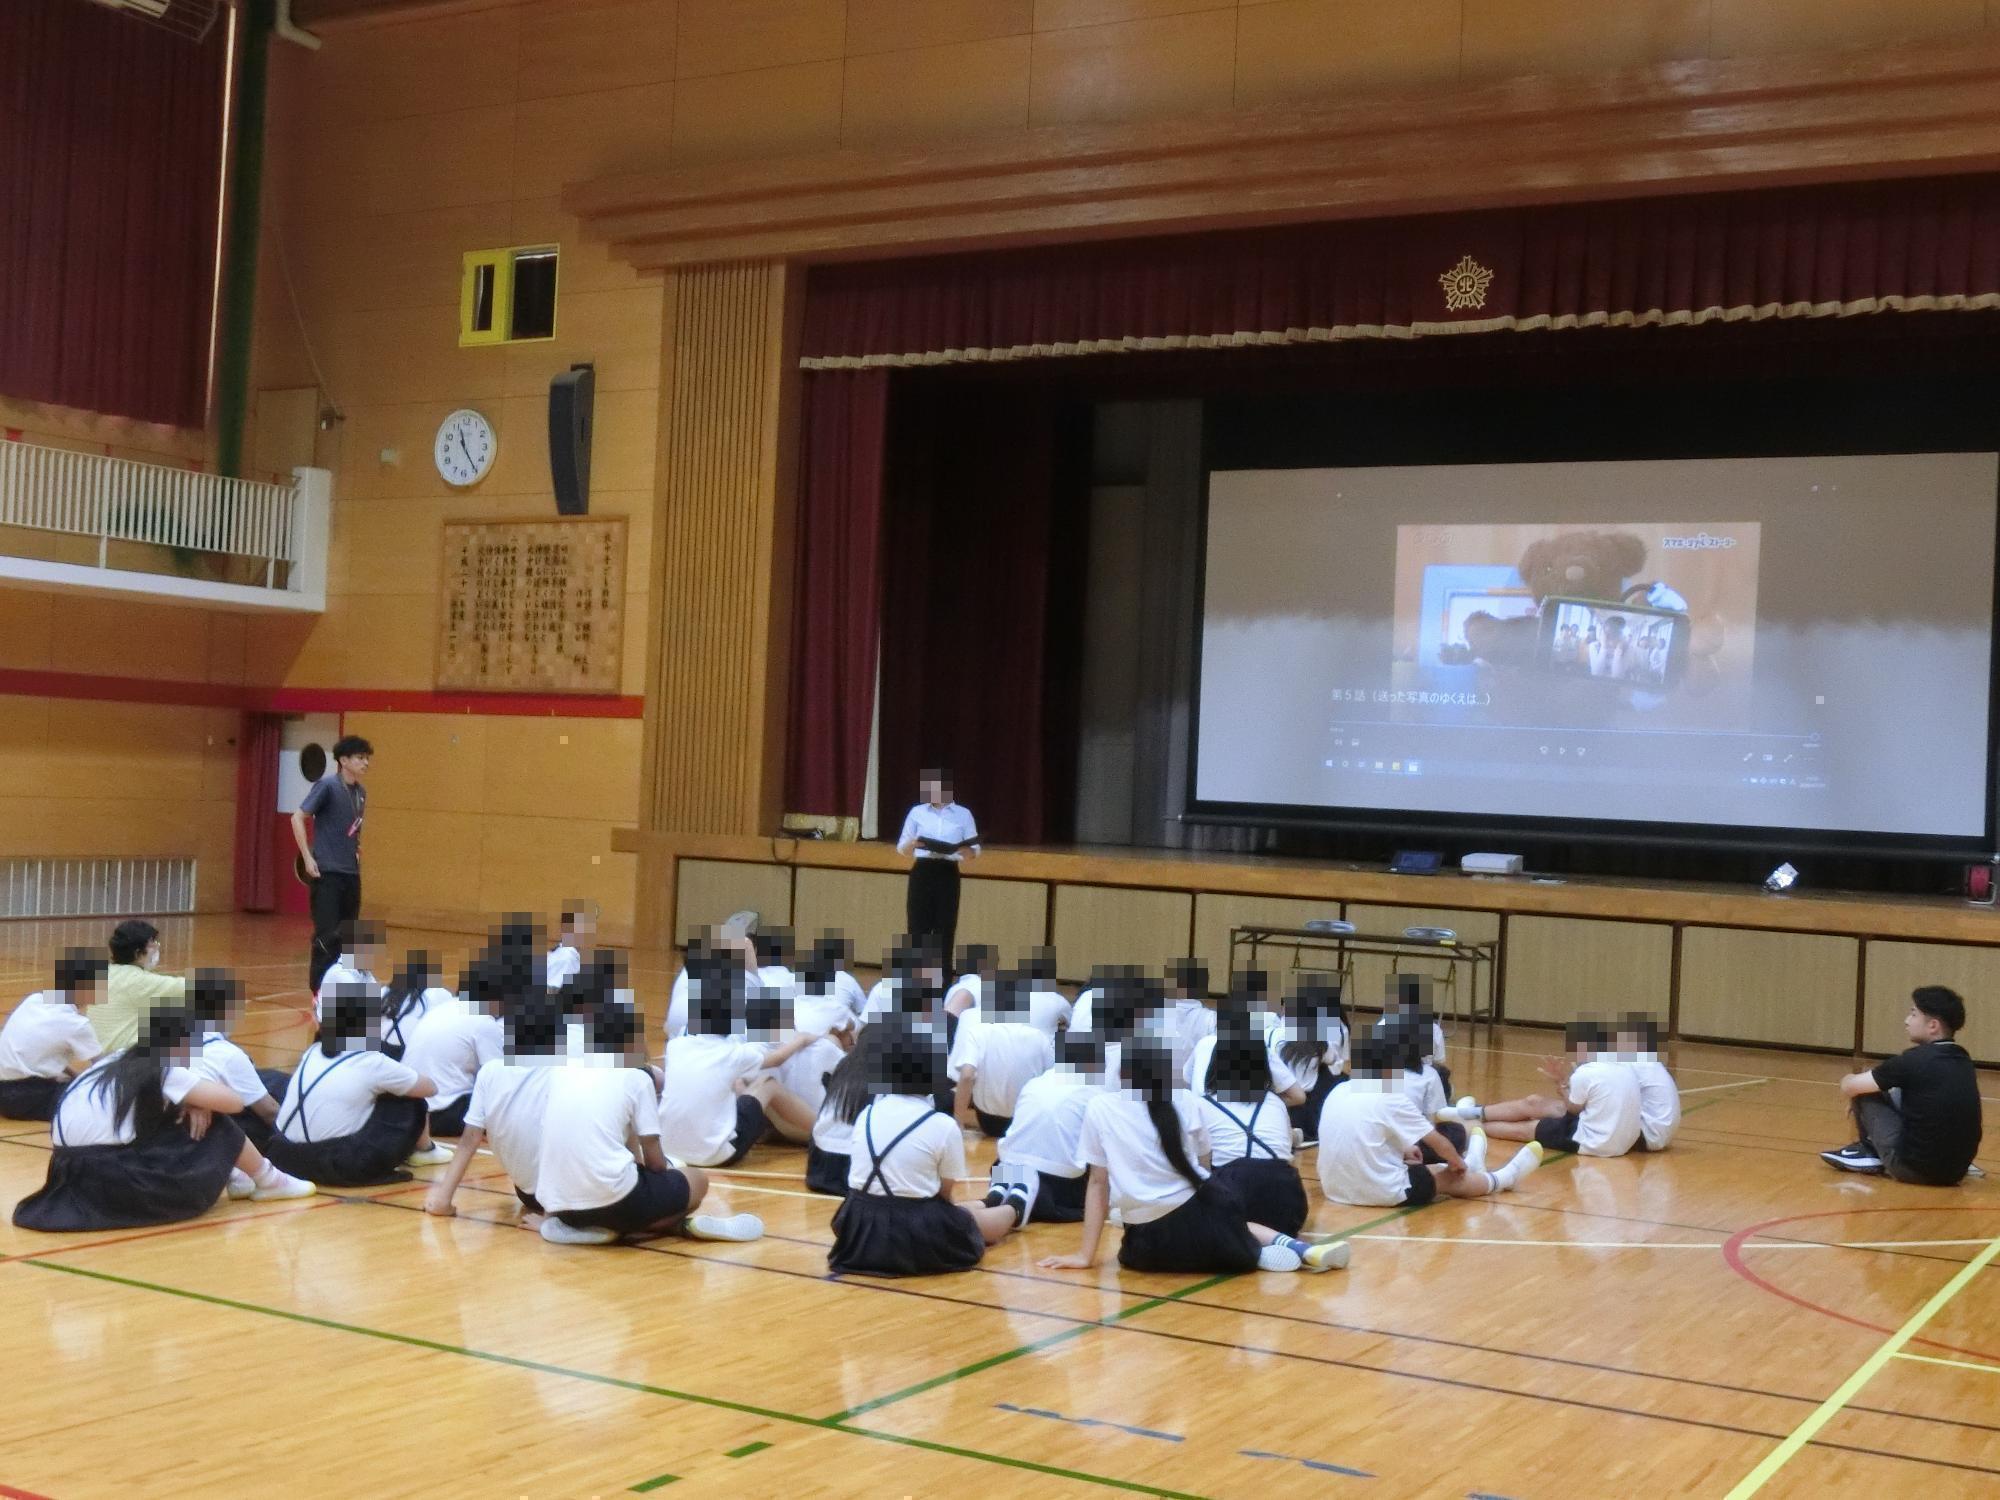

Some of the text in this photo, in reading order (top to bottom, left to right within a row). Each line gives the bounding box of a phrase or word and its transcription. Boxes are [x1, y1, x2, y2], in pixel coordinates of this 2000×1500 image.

[463, 417, 471, 426] 12
[445, 433, 454, 441] 10
[480, 430, 486, 438] 2
[443, 444, 450, 452] 9
[482, 443, 488, 451] 3
[478, 455, 485, 463] 4
[452, 466, 458, 474] 7
[460, 469, 467, 478] 6
